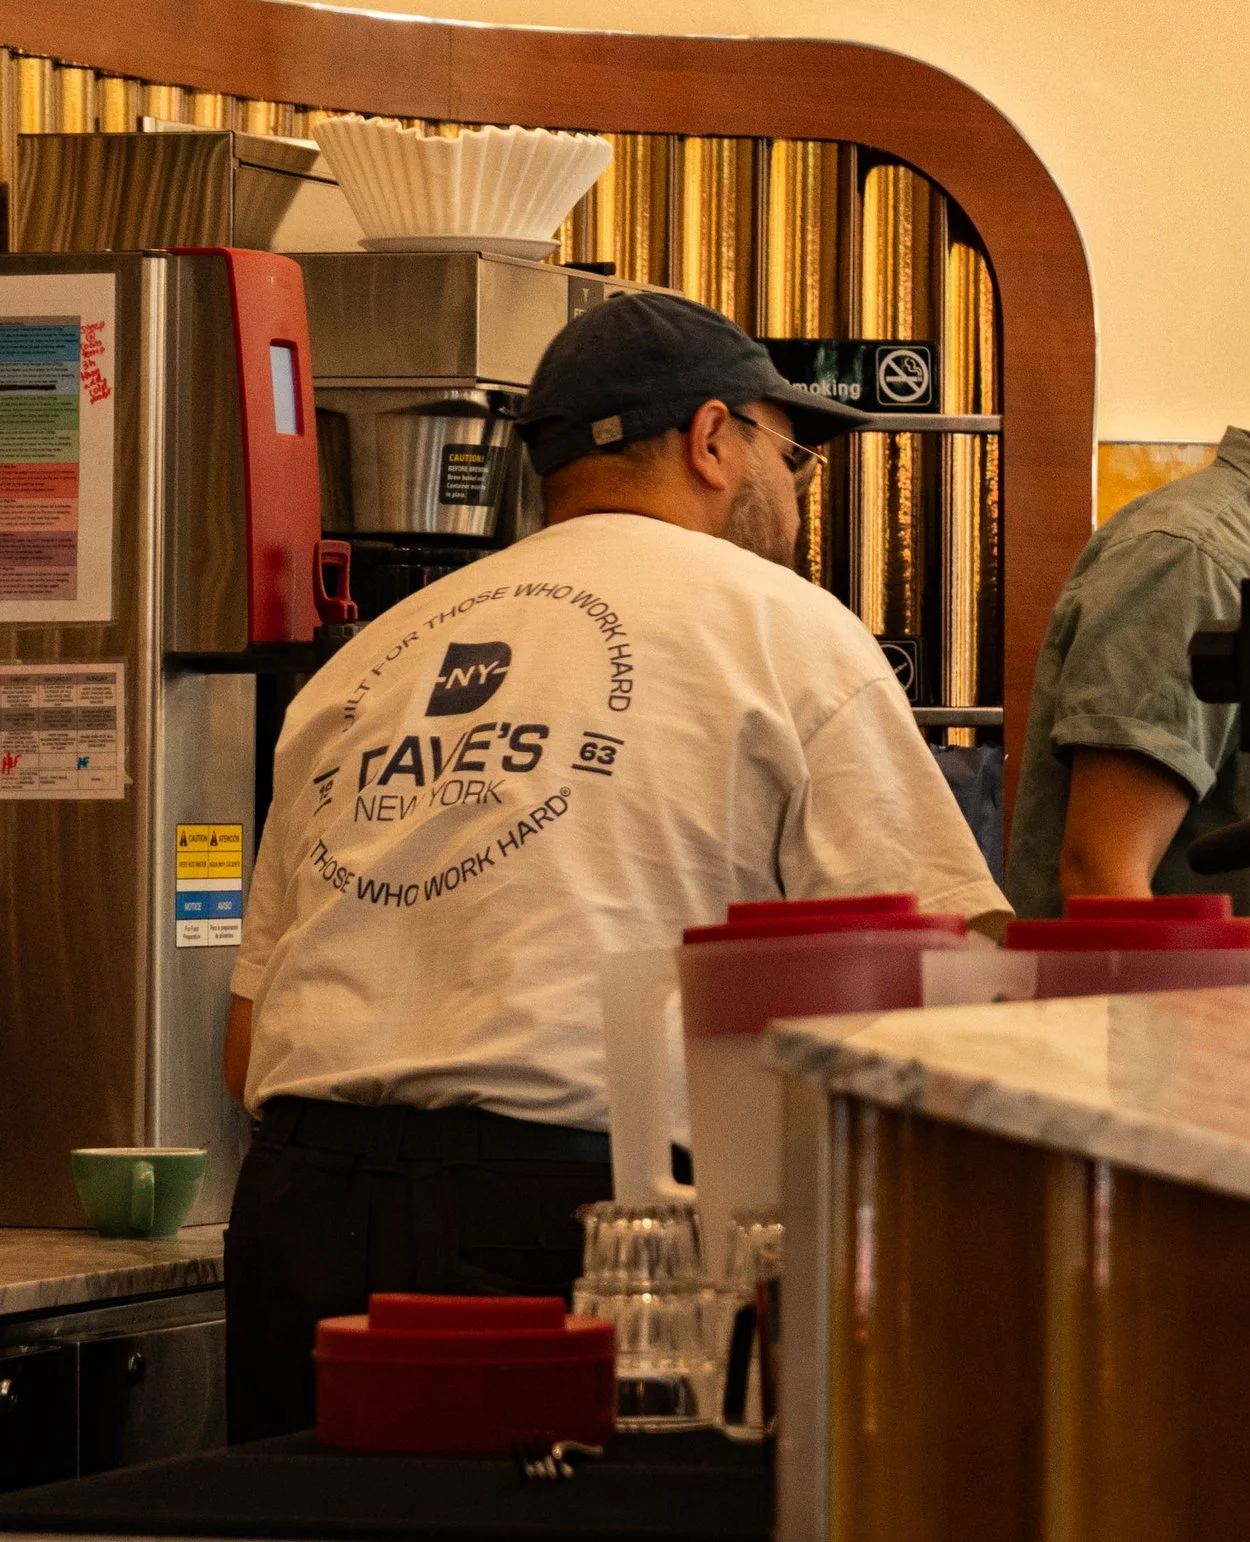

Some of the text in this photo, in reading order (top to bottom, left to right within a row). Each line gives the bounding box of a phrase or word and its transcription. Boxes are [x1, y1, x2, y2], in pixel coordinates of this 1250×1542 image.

[790, 379, 861, 400] moking
[423, 586, 510, 630] THOSE
[513, 582, 574, 601] WHO
[569, 590, 627, 643] WORK
[608, 643, 634, 712] HARD
[579, 741, 617, 765] 63
[428, 779, 506, 808] YORK
[357, 876, 419, 907] WHO
[424, 846, 495, 901] WORK
